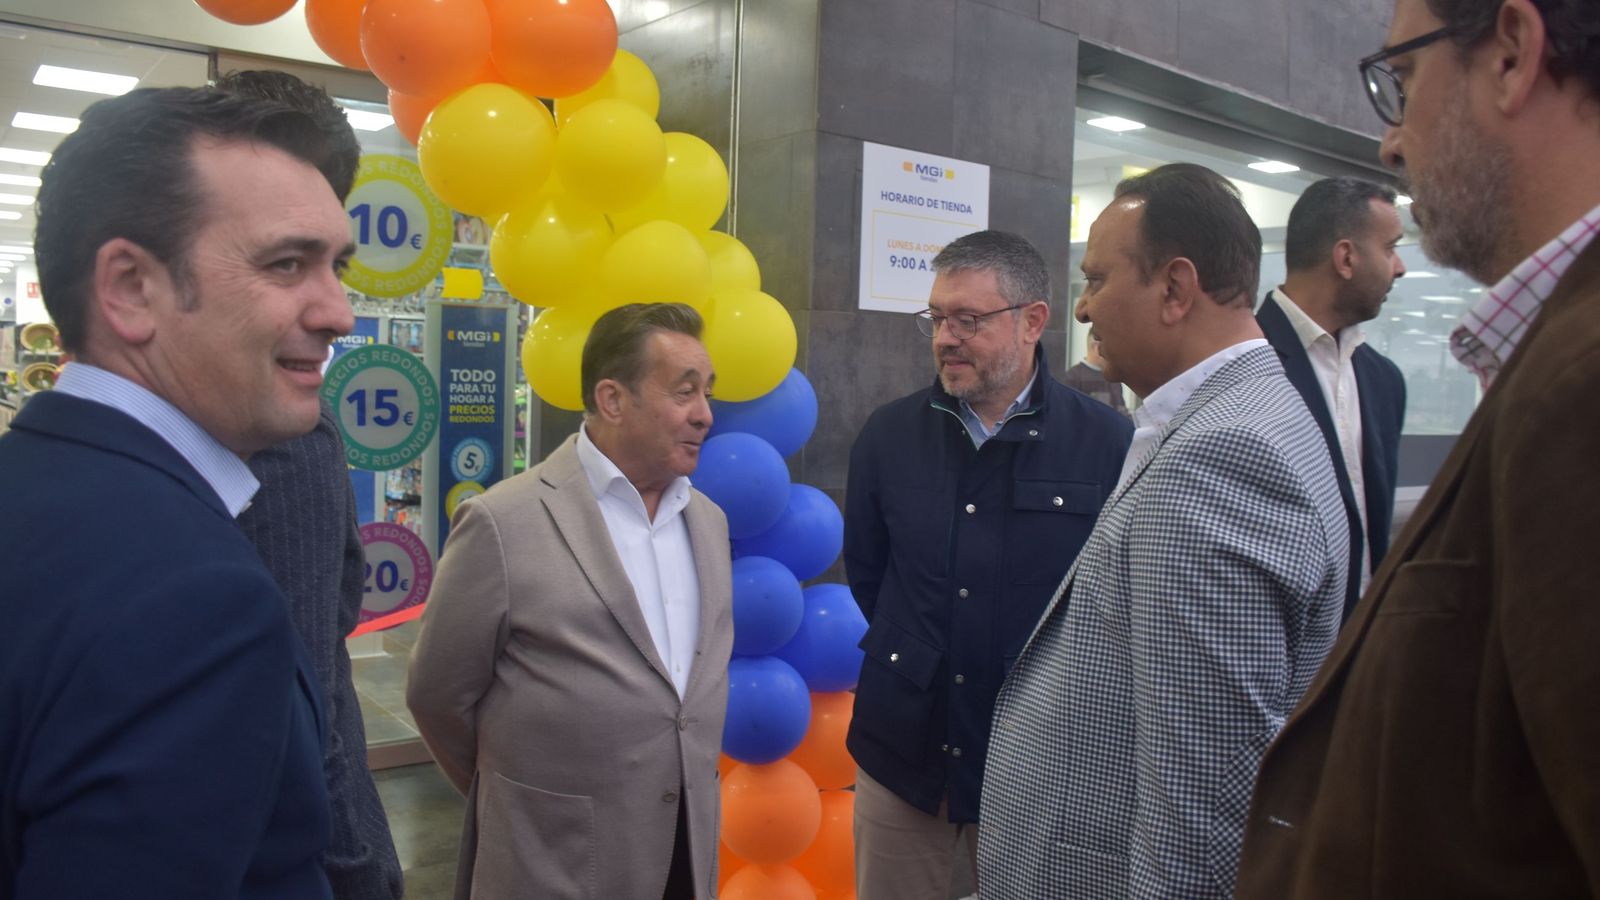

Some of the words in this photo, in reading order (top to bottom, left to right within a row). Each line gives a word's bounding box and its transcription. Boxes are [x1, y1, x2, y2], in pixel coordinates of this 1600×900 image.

[881, 190, 925, 207] HORARIO
[927, 198, 939, 209] DE
[940, 200, 973, 214] TIENDA
[887, 239, 914, 251] LUNES
[915, 243, 922, 252] A
[889, 255, 916, 270] 9:00
[918, 259, 927, 271] A
[371, 350, 436, 407] REDONDOS
[450, 369, 496, 383] TODO
[449, 383, 480, 394] PARA
[481, 383, 496, 394] TU
[449, 395, 486, 404] HOGAR
[487, 395, 495, 404] A
[449, 404, 496, 415] PRECIOS
[449, 415, 496, 424] REDONDOS
[372, 412, 435, 467] REDONDOS
